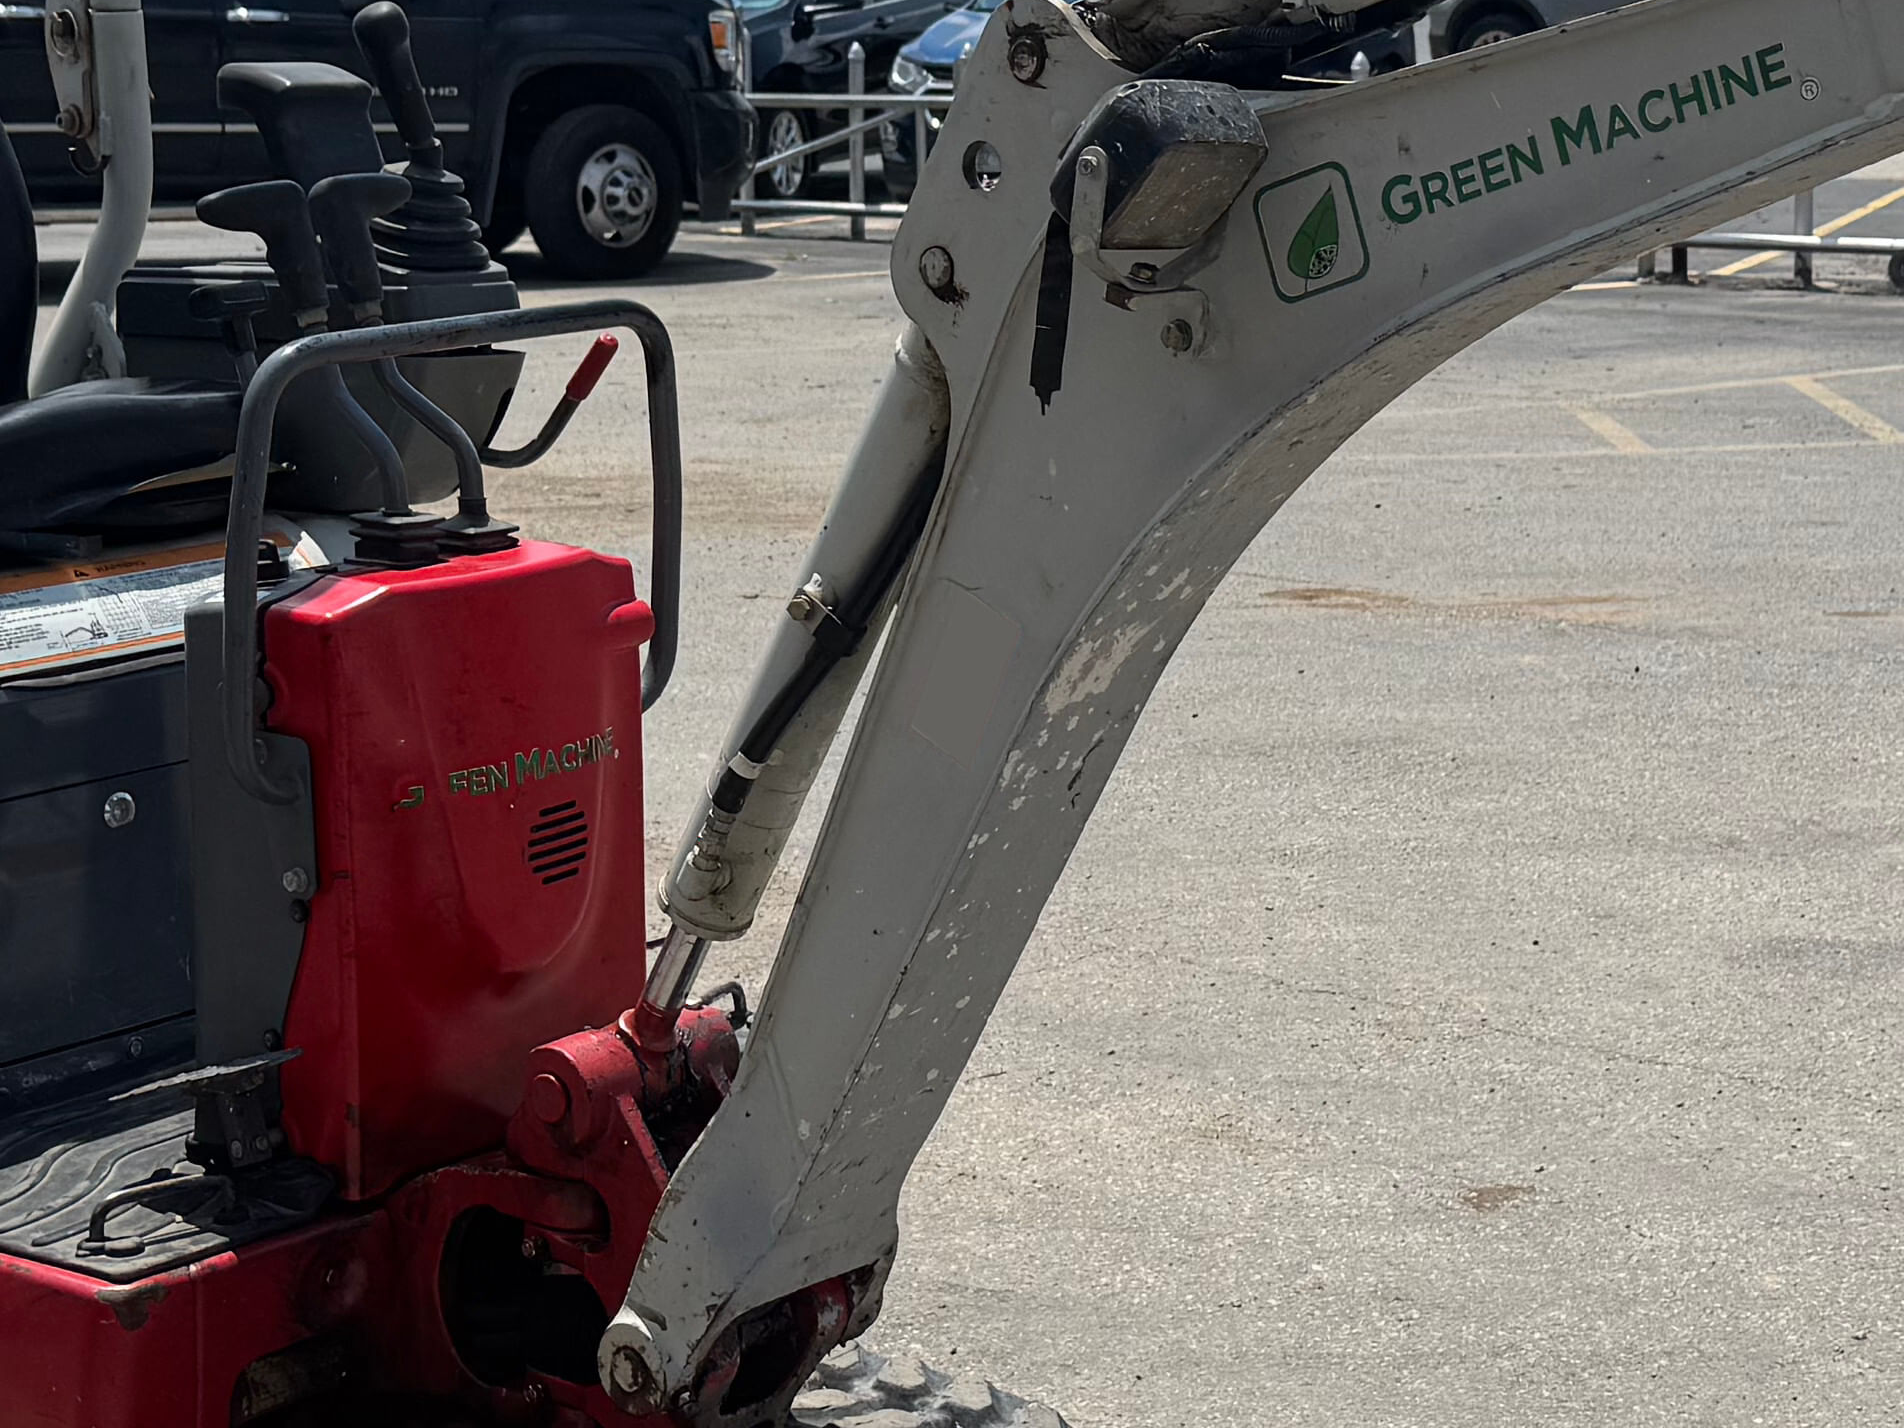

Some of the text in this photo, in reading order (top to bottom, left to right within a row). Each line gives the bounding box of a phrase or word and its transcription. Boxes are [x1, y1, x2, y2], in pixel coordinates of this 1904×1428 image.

[1381, 134, 1545, 225] GREEN
[1550, 42, 1793, 166] MACHINE
[514, 725, 614, 786] MACHINE
